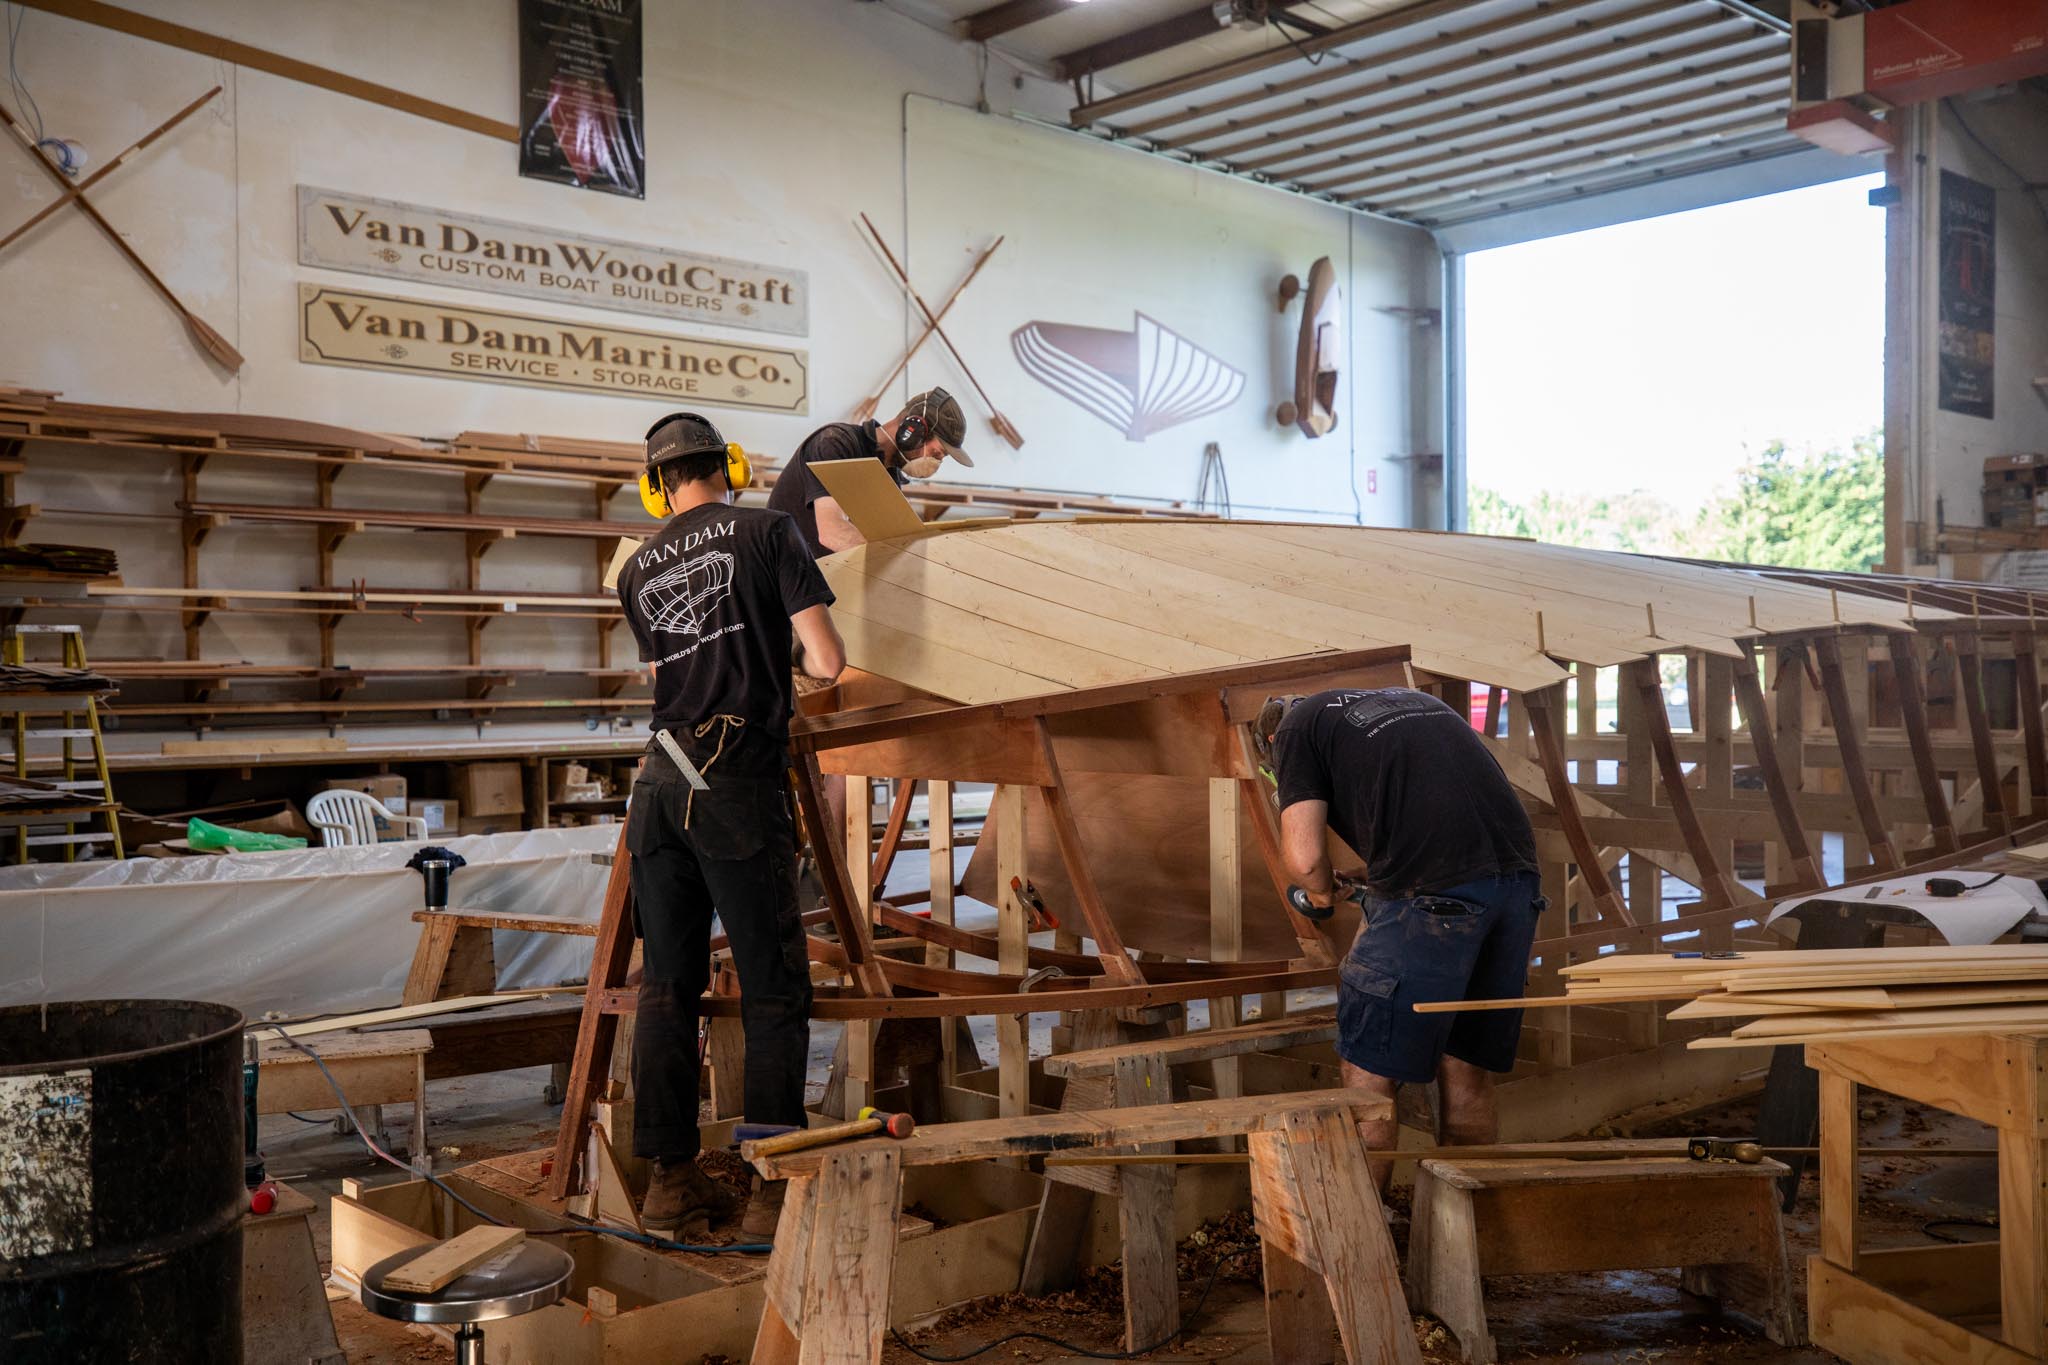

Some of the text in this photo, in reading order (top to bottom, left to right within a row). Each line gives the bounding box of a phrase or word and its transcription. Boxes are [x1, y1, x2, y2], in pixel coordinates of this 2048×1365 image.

[325, 204, 426, 248] Van
[438, 223, 551, 267] Dam
[420, 254, 722, 312] CUSTOM BOAT BUILDERS
[326, 301, 427, 342] Van
[437, 315, 552, 355] Dam
[450, 352, 698, 392] SERVICE STORAGE
[638, 520, 736, 571] VAN DAM
